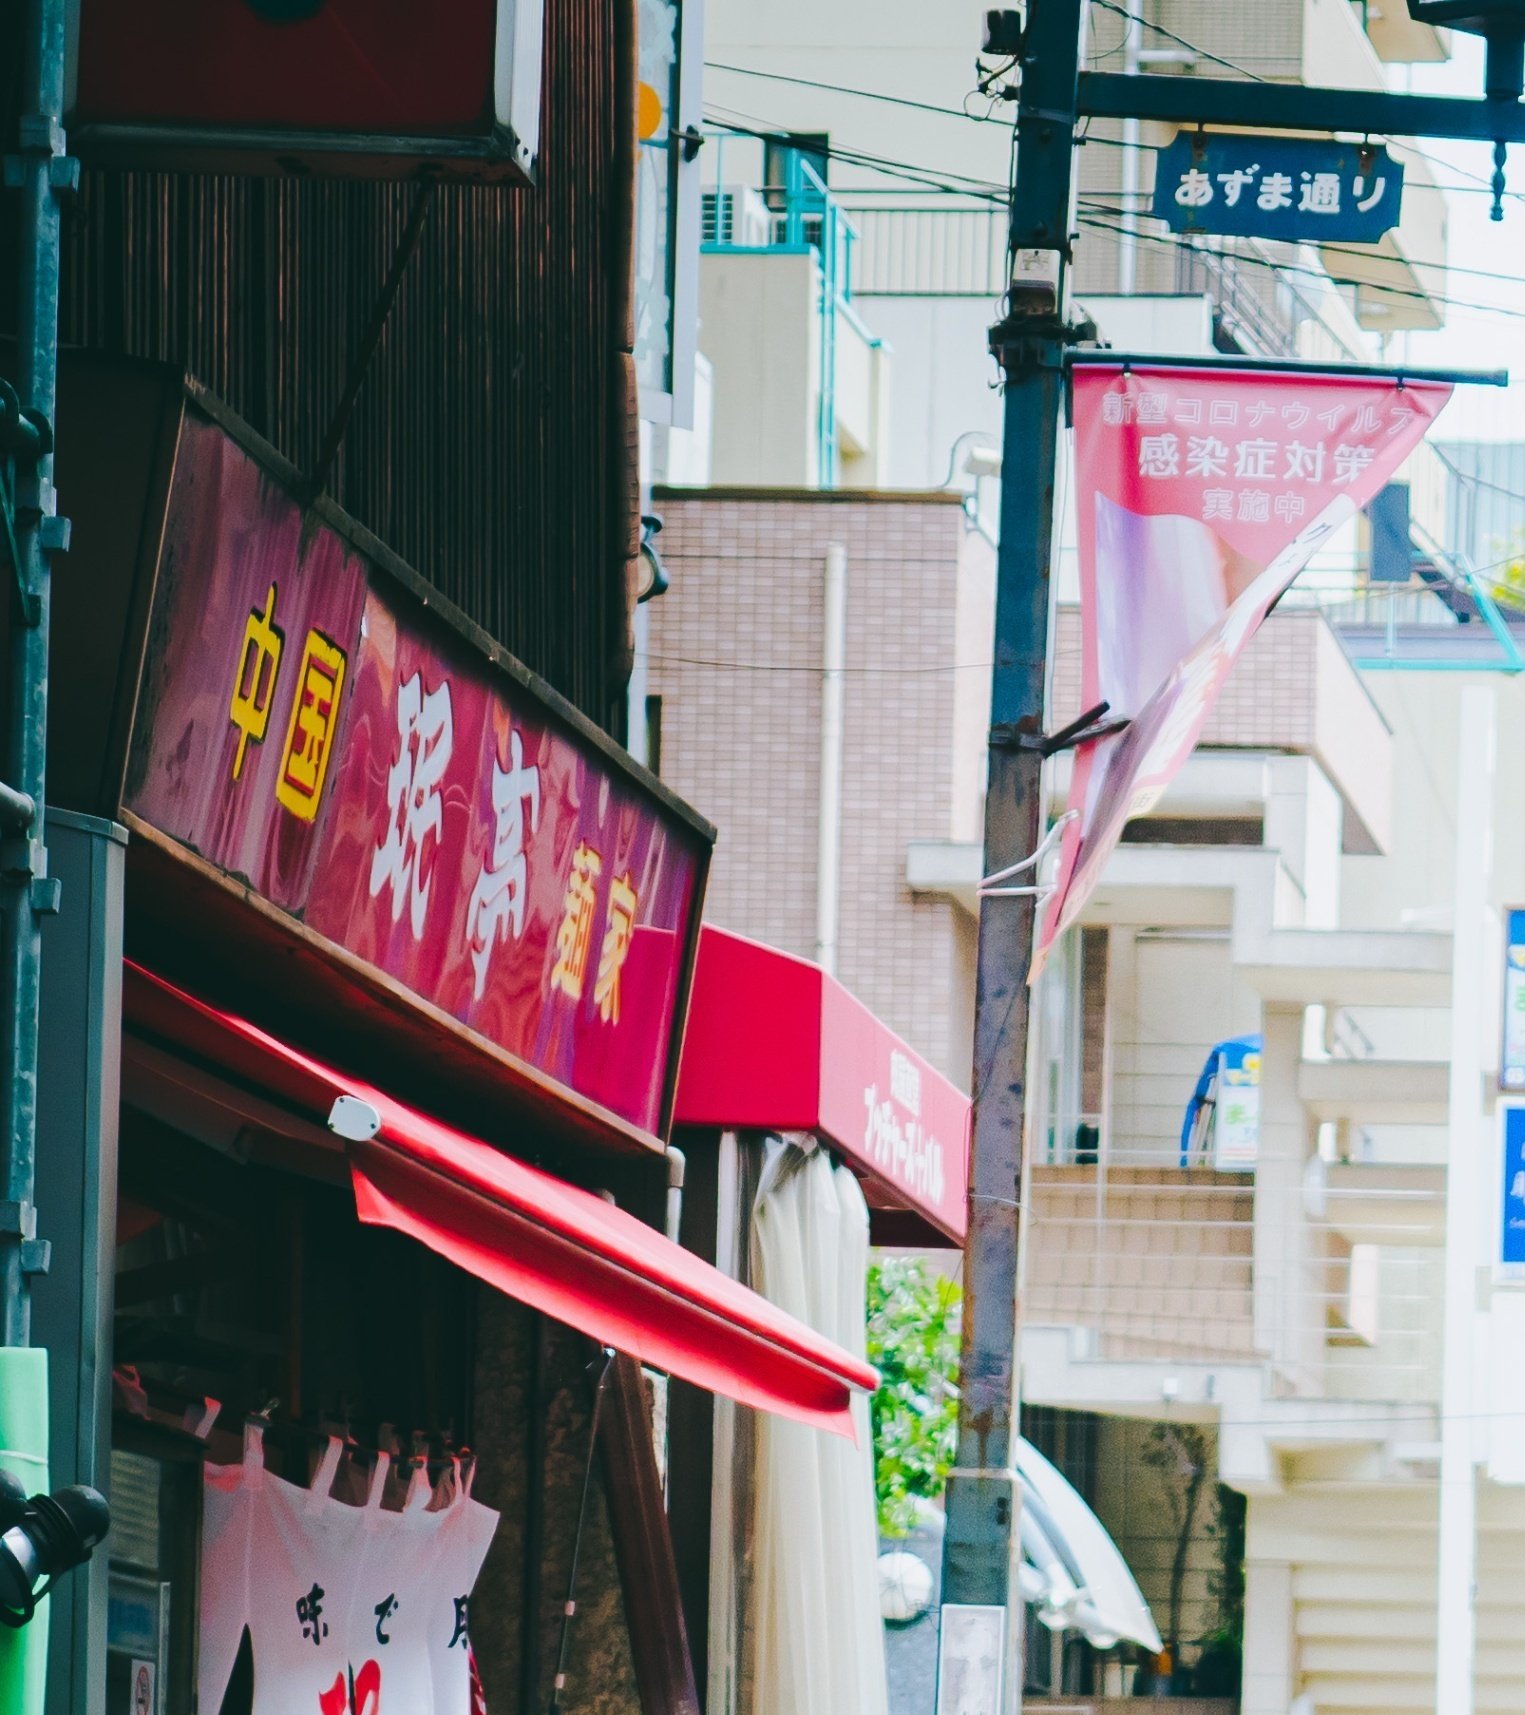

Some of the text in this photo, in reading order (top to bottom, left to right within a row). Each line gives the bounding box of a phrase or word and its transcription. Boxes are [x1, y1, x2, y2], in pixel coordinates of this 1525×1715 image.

[1174, 165, 1386, 216] あずま通り
[1138, 432, 1377, 485] 感染症対策
[1202, 487, 1305, 524] 実施中
[230, 581, 348, 824] 中国
